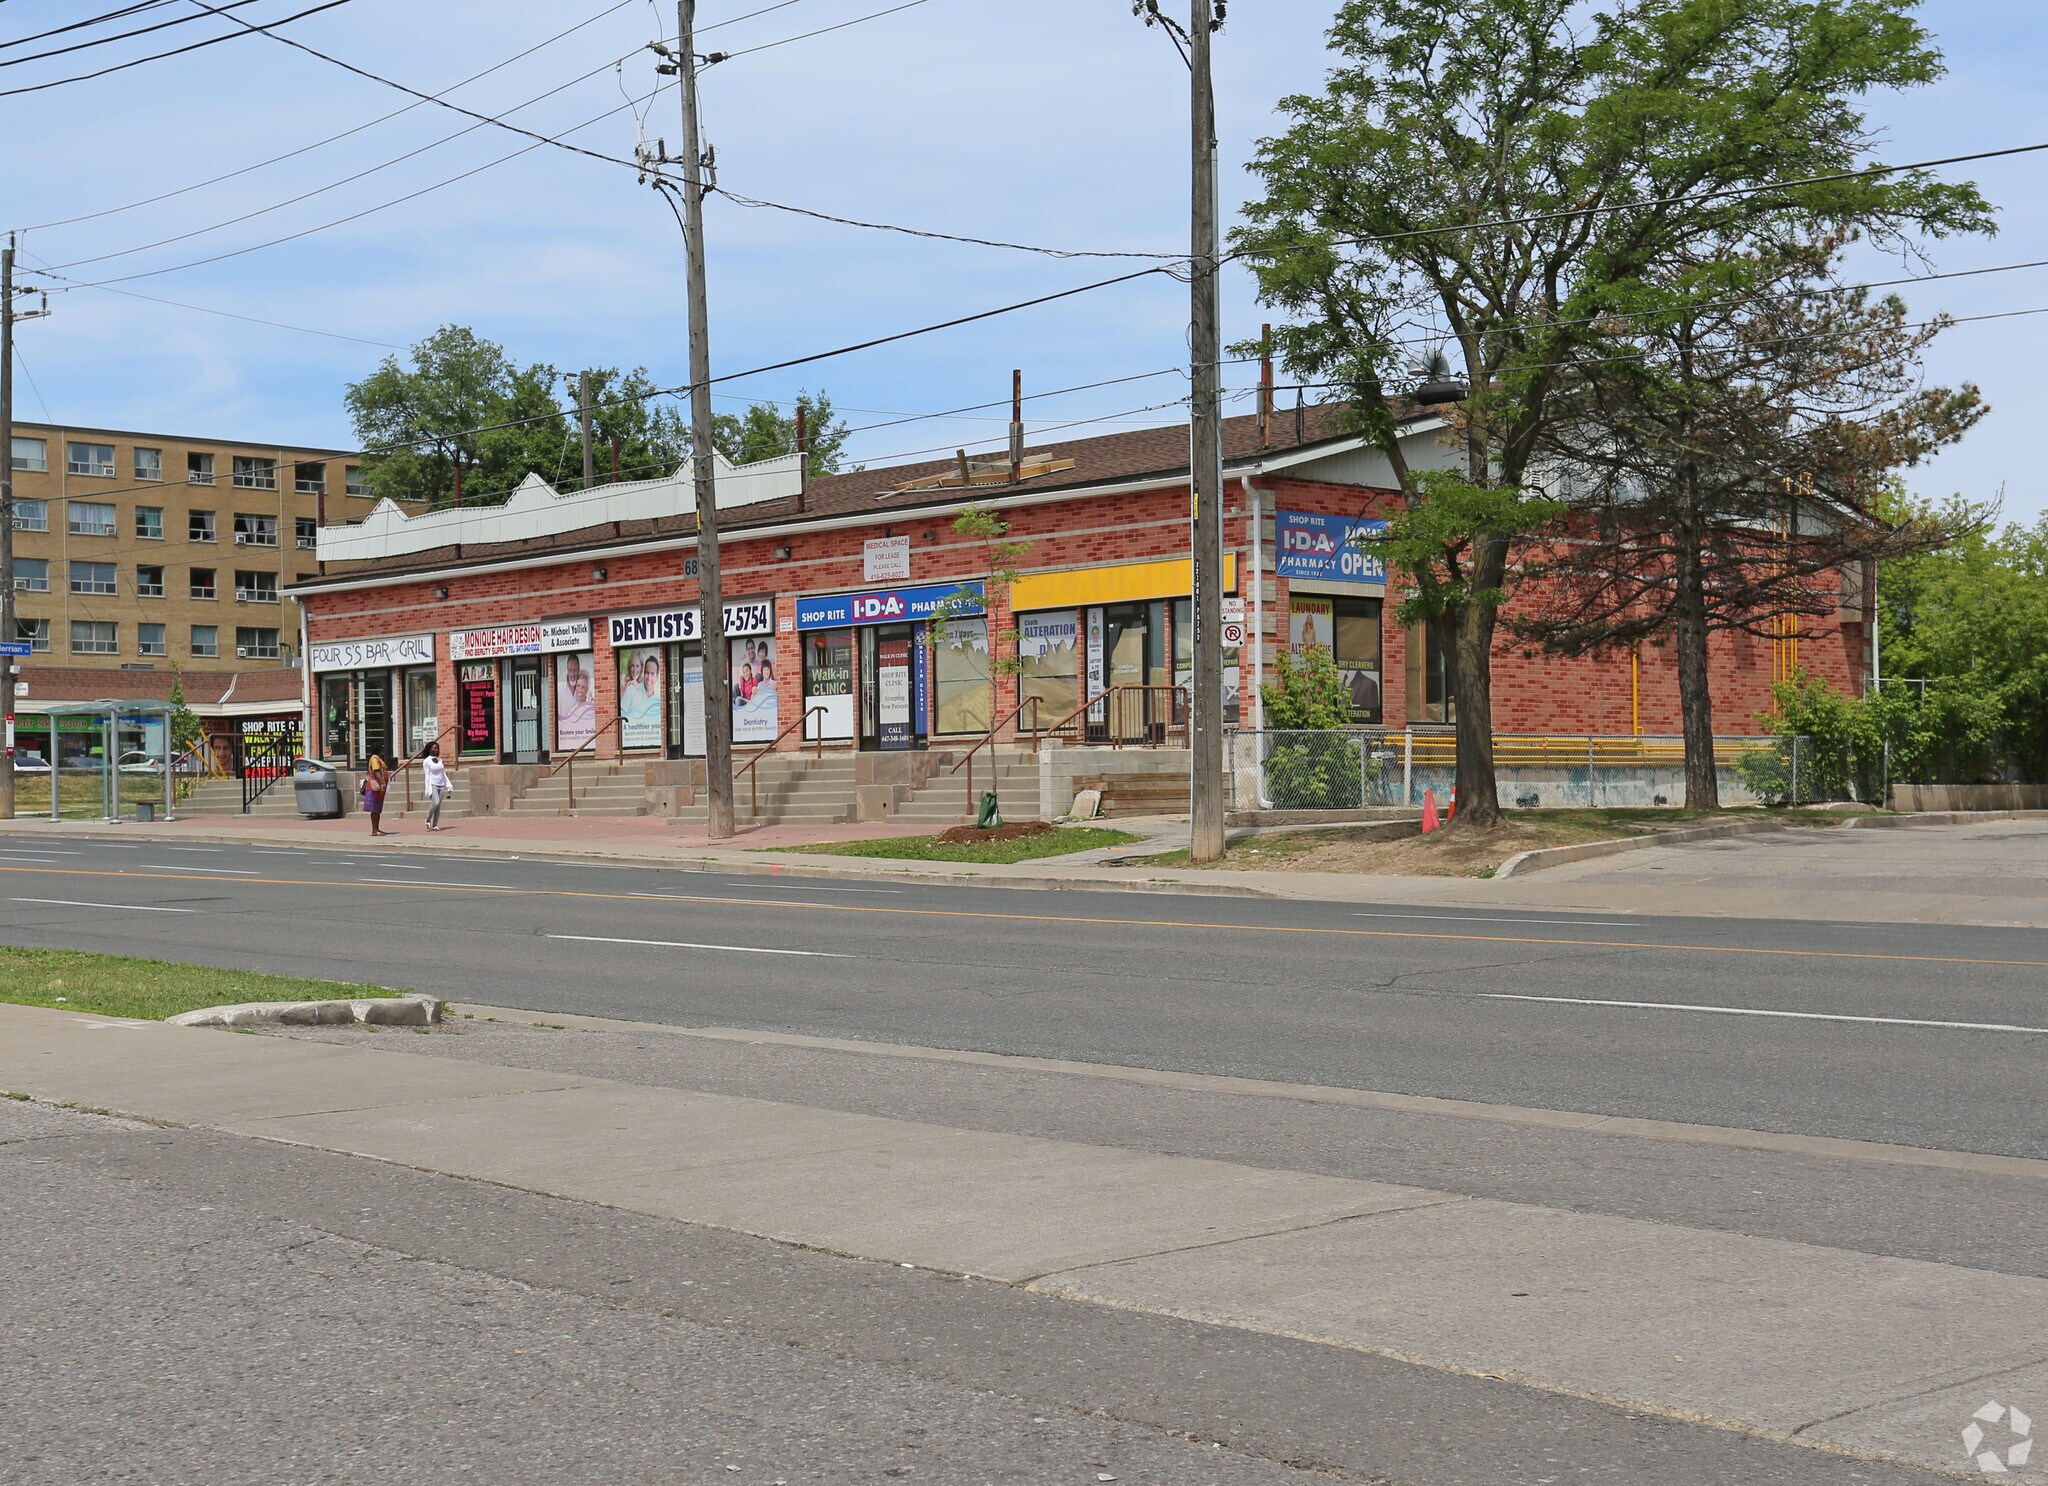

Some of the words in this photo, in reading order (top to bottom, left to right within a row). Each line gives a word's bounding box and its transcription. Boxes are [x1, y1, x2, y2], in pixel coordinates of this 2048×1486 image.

[1289, 515, 1309, 524] SHOP
[1310, 518, 1325, 526] RITE
[866, 541, 889, 550] MEDICAL
[891, 539, 908, 547] SPACE
[885, 552, 900, 560] LEASE
[1281, 556, 1337, 570] PHARMACY
[1341, 552, 1383, 577] OPEN
[1291, 601, 1330, 615] LAUNDARY
[802, 611, 825, 623] SHOP
[828, 609, 845, 621] RITE
[551, 625, 570, 636] Michael
[612, 612, 694, 642] DENTISTS
[1024, 623, 1076, 638] ALTERATION
[464, 629, 496, 648] MONIQUE
[497, 628, 513, 645] HAIR
[515, 625, 540, 644] DESIGN
[551, 639, 555, 647] &
[556, 636, 580, 647] Associate
[0, 645, 23, 653] errian
[313, 647, 343, 668] FOUR
[366, 642, 391, 664] BAR
[492, 646, 508, 655] SUPPLY
[1350, 661, 1374, 670] CLEANERS
[811, 667, 849, 682] Walk-in
[812, 681, 847, 696] CLINIC
[60, 719, 87, 728] Salon
[242, 721, 264, 733] SHOP
[267, 720, 286, 732] RITE
[744, 717, 769, 726] Dentistry
